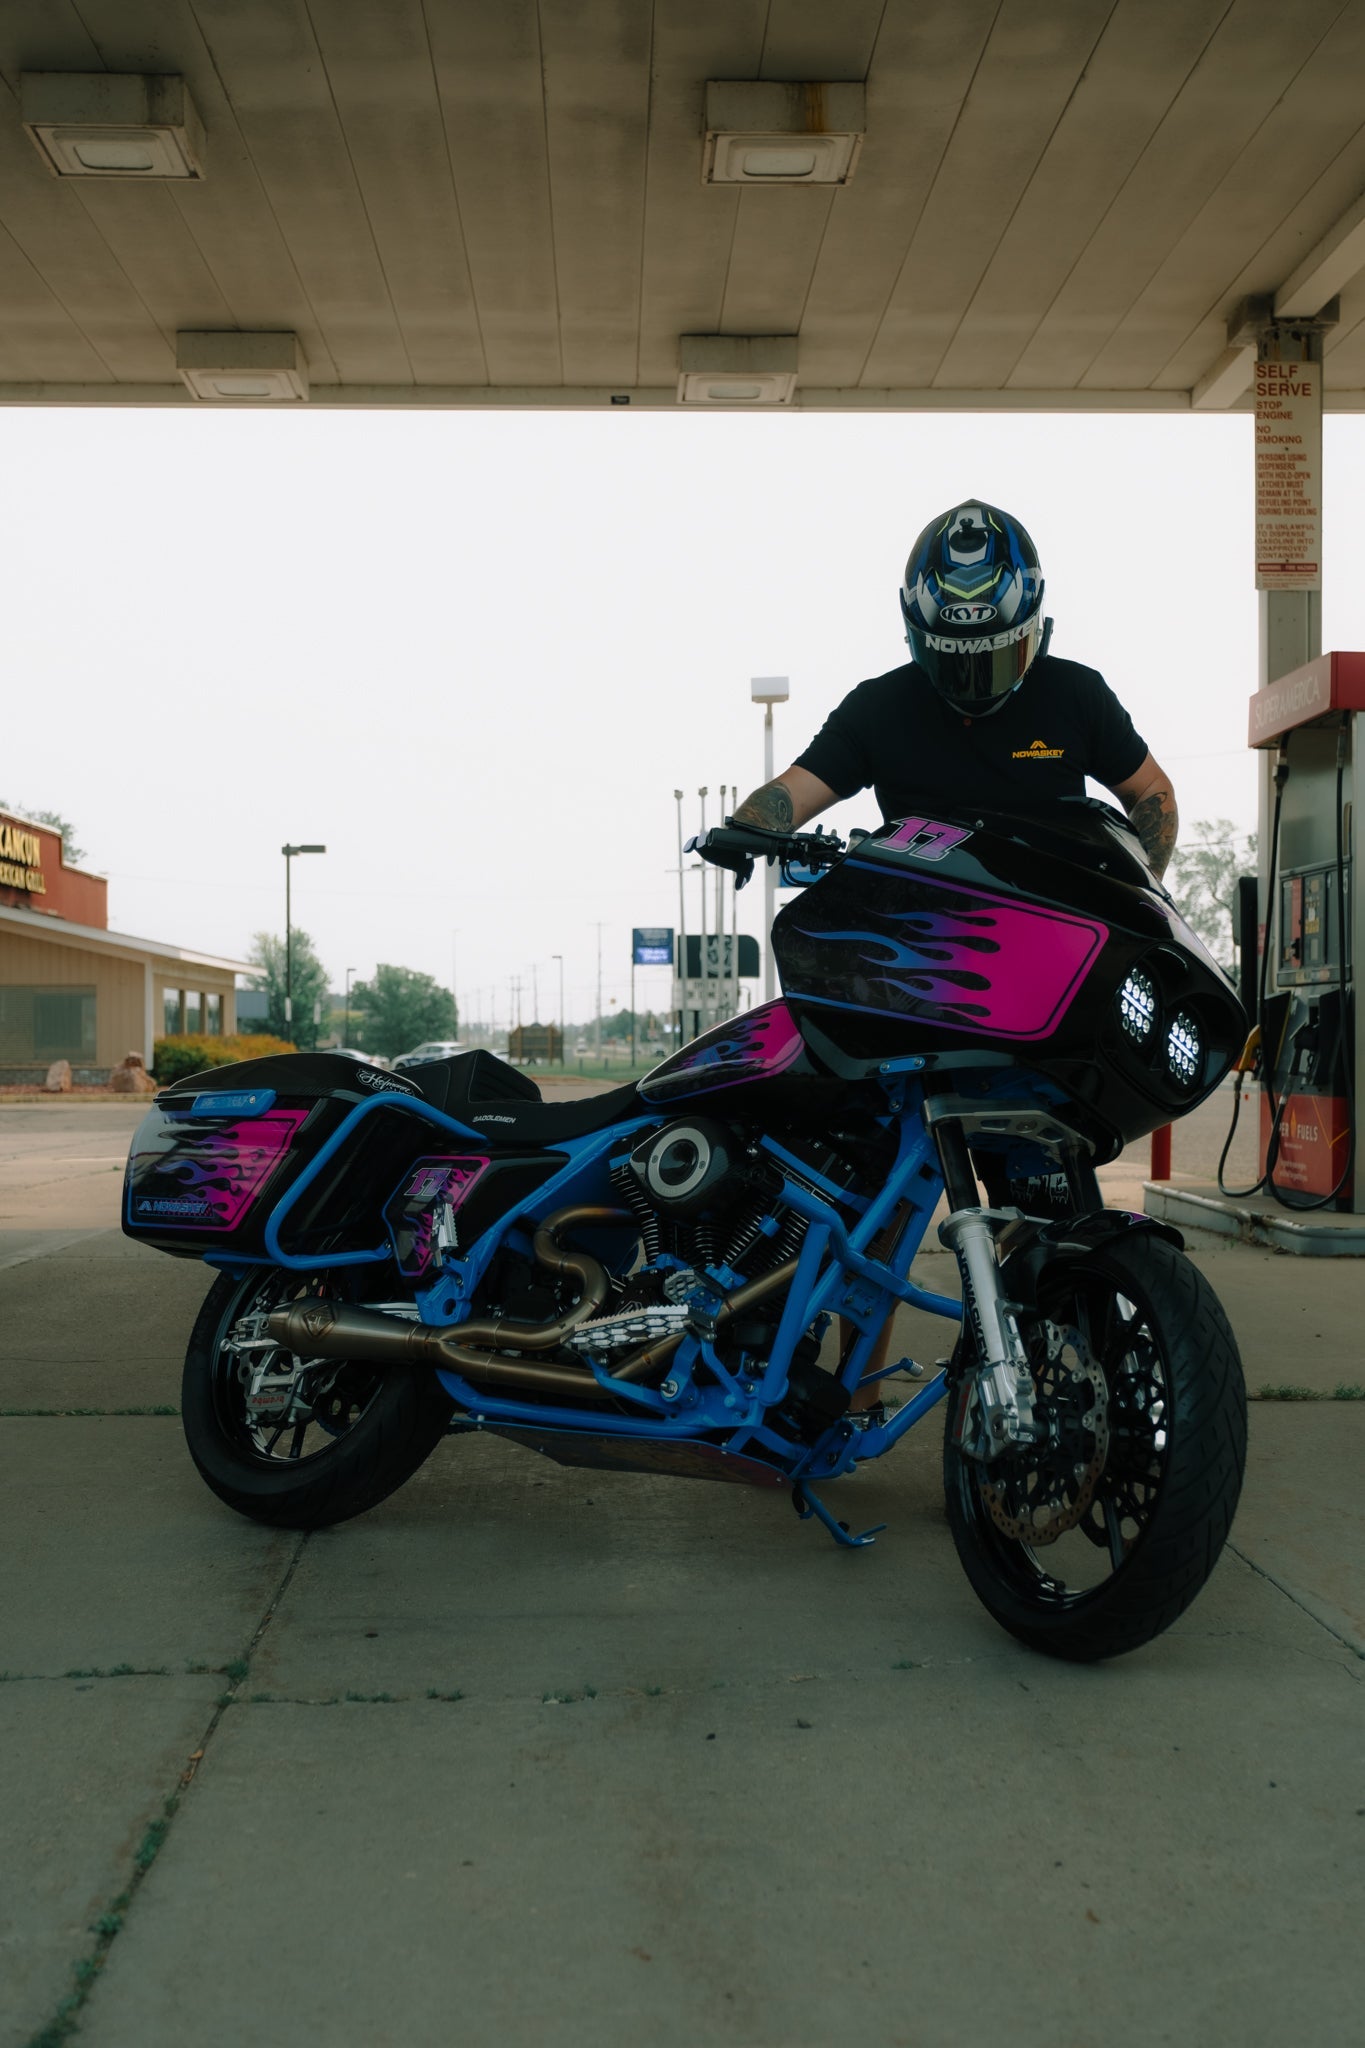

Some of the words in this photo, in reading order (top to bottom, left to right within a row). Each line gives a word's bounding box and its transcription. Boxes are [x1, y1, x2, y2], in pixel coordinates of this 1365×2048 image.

[1257, 365, 1298, 378] SELF
[1257, 383, 1311, 396] SERVE
[1257, 401, 1282, 409] STOP
[1257, 411, 1293, 420] ENGINE
[1257, 435, 1302, 444] SMOKING
[945, 607, 988, 620] KYT
[925, 616, 1034, 654] NOWASKE
[1012, 750, 1065, 759] NOWASKEY
[872, 816, 973, 861] 17
[1297, 1124, 1319, 1141] FUELS
[404, 1167, 452, 1196] 17
[153, 1200, 209, 1214] NOWASKEY
[956, 1248, 991, 1365] NOWASKEY
